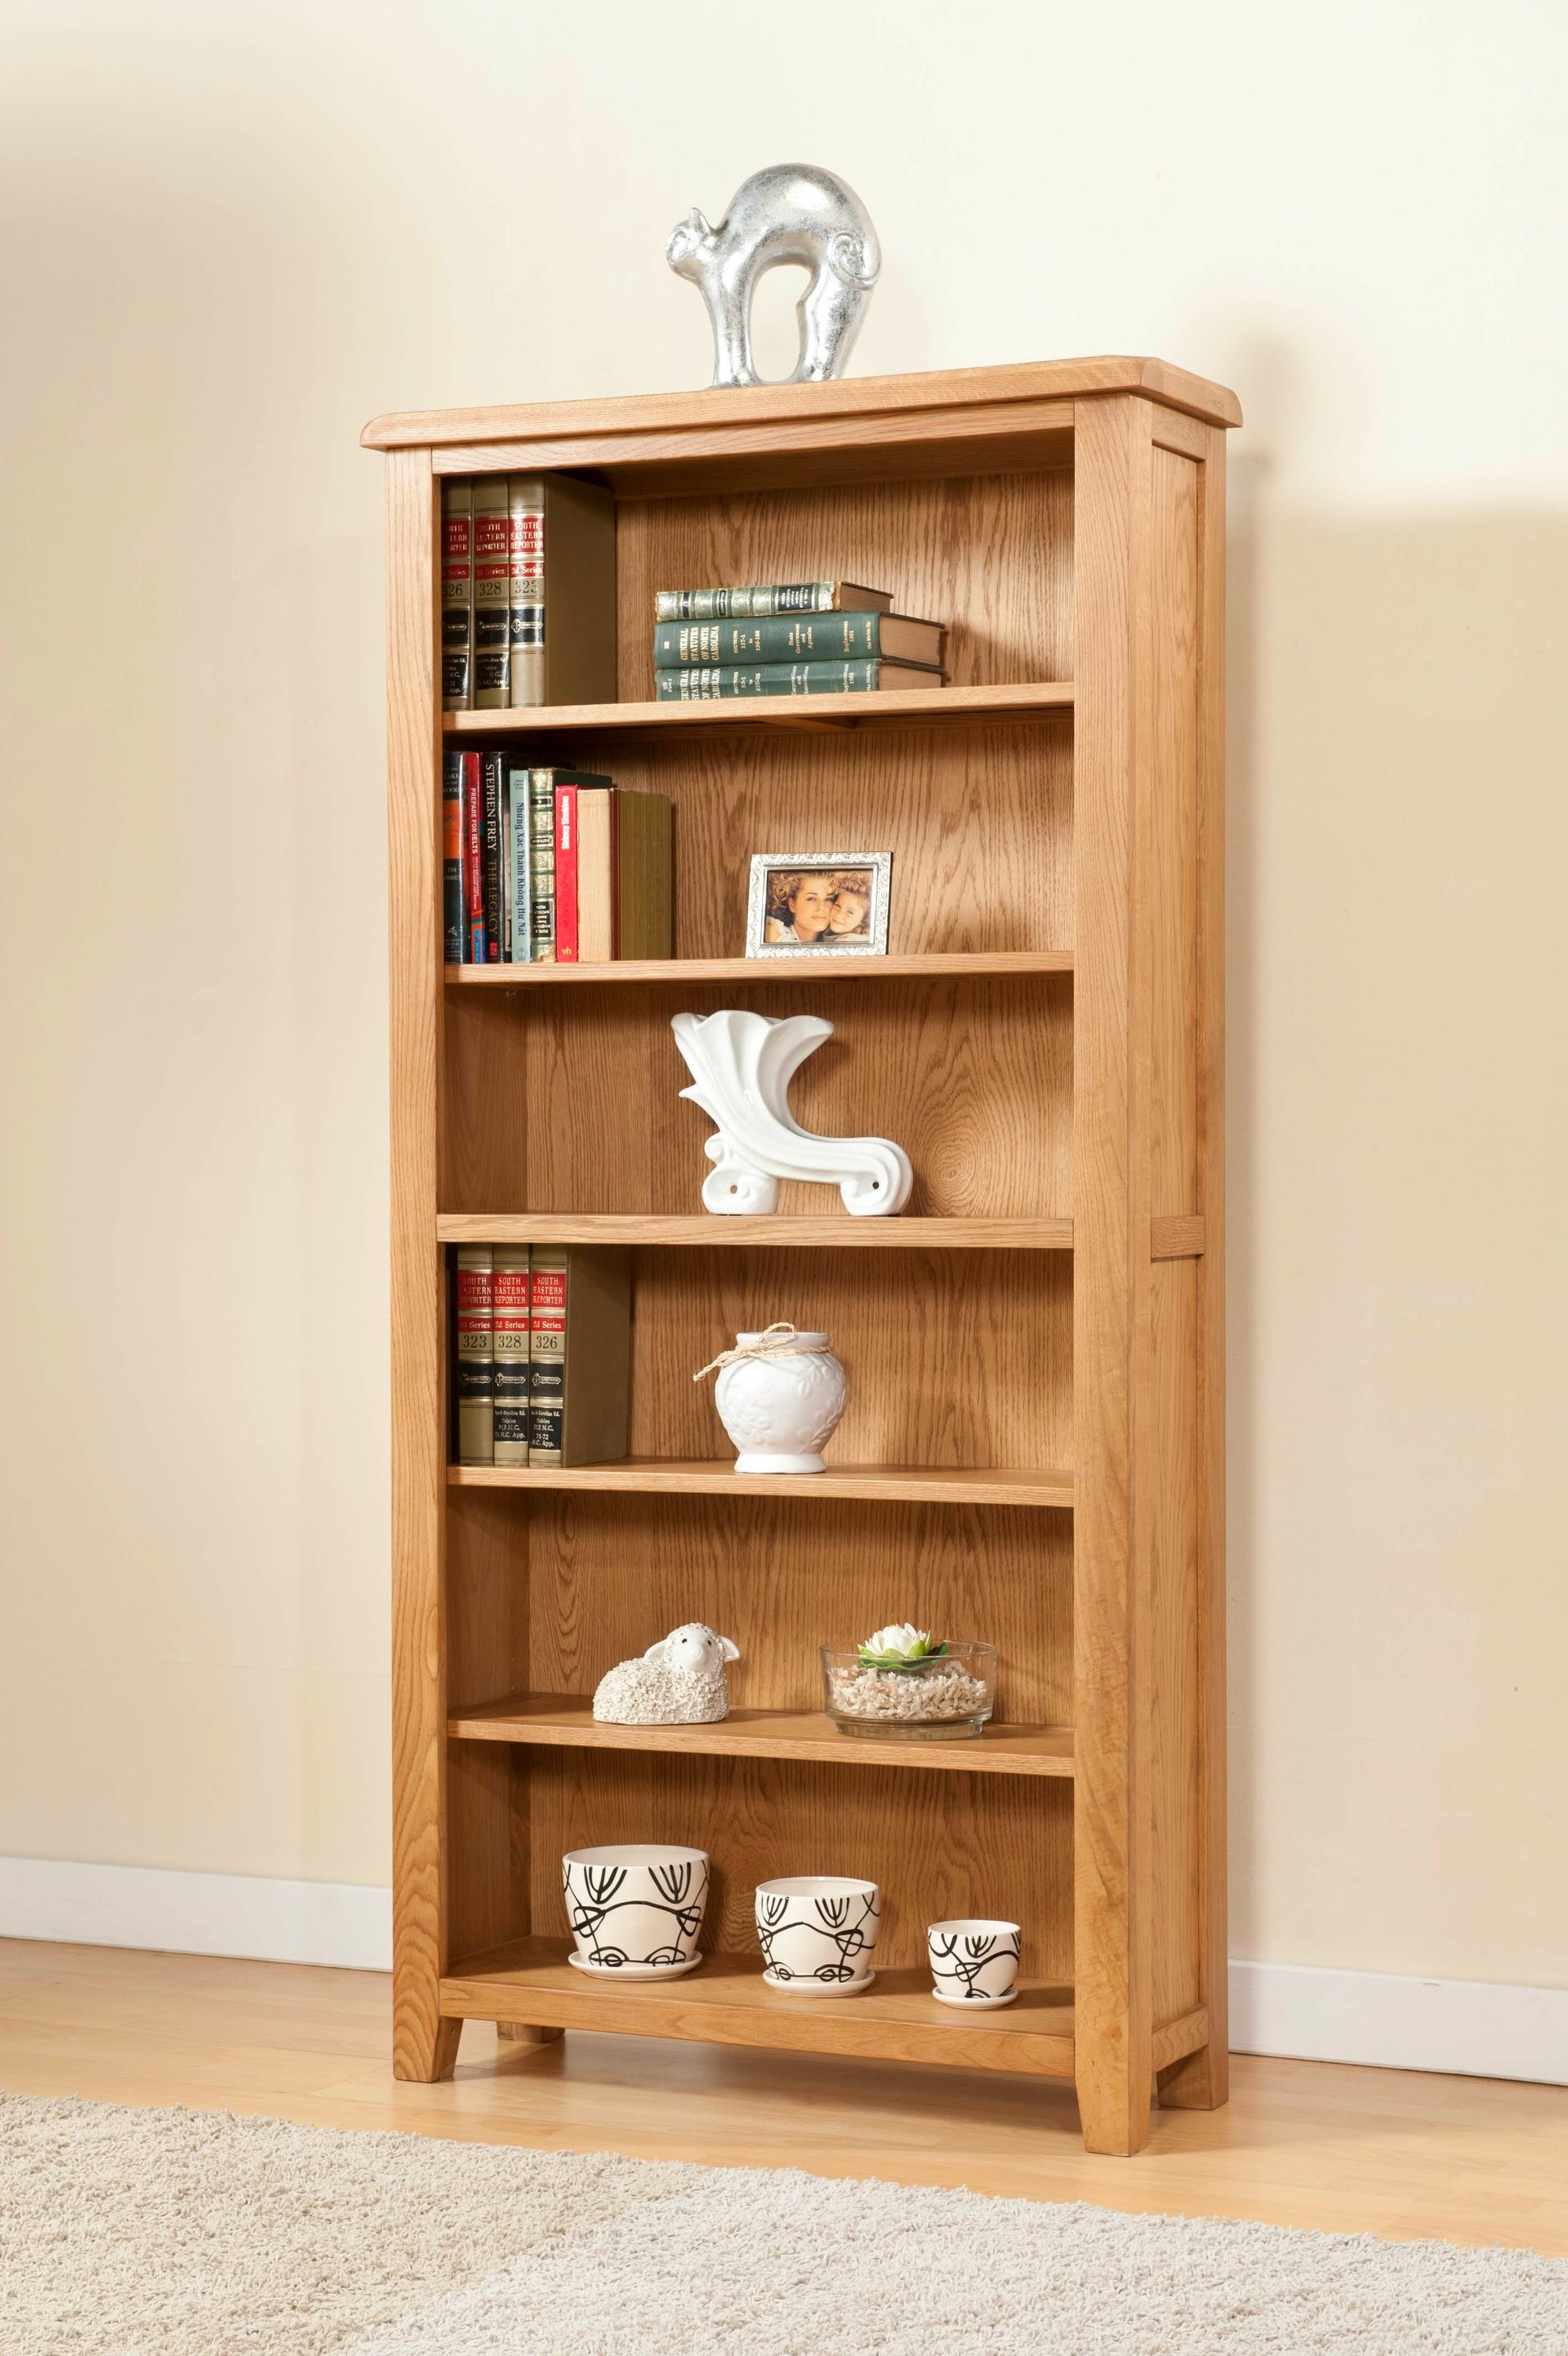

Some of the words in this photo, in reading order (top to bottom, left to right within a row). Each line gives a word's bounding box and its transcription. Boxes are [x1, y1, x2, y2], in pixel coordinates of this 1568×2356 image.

[510, 531, 543, 540] EASTERN
[514, 522, 539, 530] SOUTH
[477, 532, 506, 542] ASTERN
[510, 541, 543, 550] REPORTER
[479, 581, 502, 596] 328
[514, 580, 538, 594] 323
[679, 628, 688, 661] GENERAL
[690, 627, 699, 661] STATUTES
[701, 627, 709, 650] NORTH
[710, 626, 719, 661] CAROLINA
[701, 651, 709, 660] OF
[679, 670, 688, 701] GENERAL
[690, 669, 700, 701] STATUTES
[701, 668, 710, 691] NORTH
[711, 668, 720, 700] CAROLINA
[485, 764, 497, 817] STEPHEN
[488, 821, 497, 851] FREY
[488, 858, 497, 883] THE
[488, 887, 497, 934] LEGACY
[494, 1286, 526, 1294] EASTERN
[537, 1276, 559, 1285] SOUTH
[463, 1335, 487, 1348] 323
[498, 1335, 522, 1348] 328
[536, 1336, 558, 1349] 326
